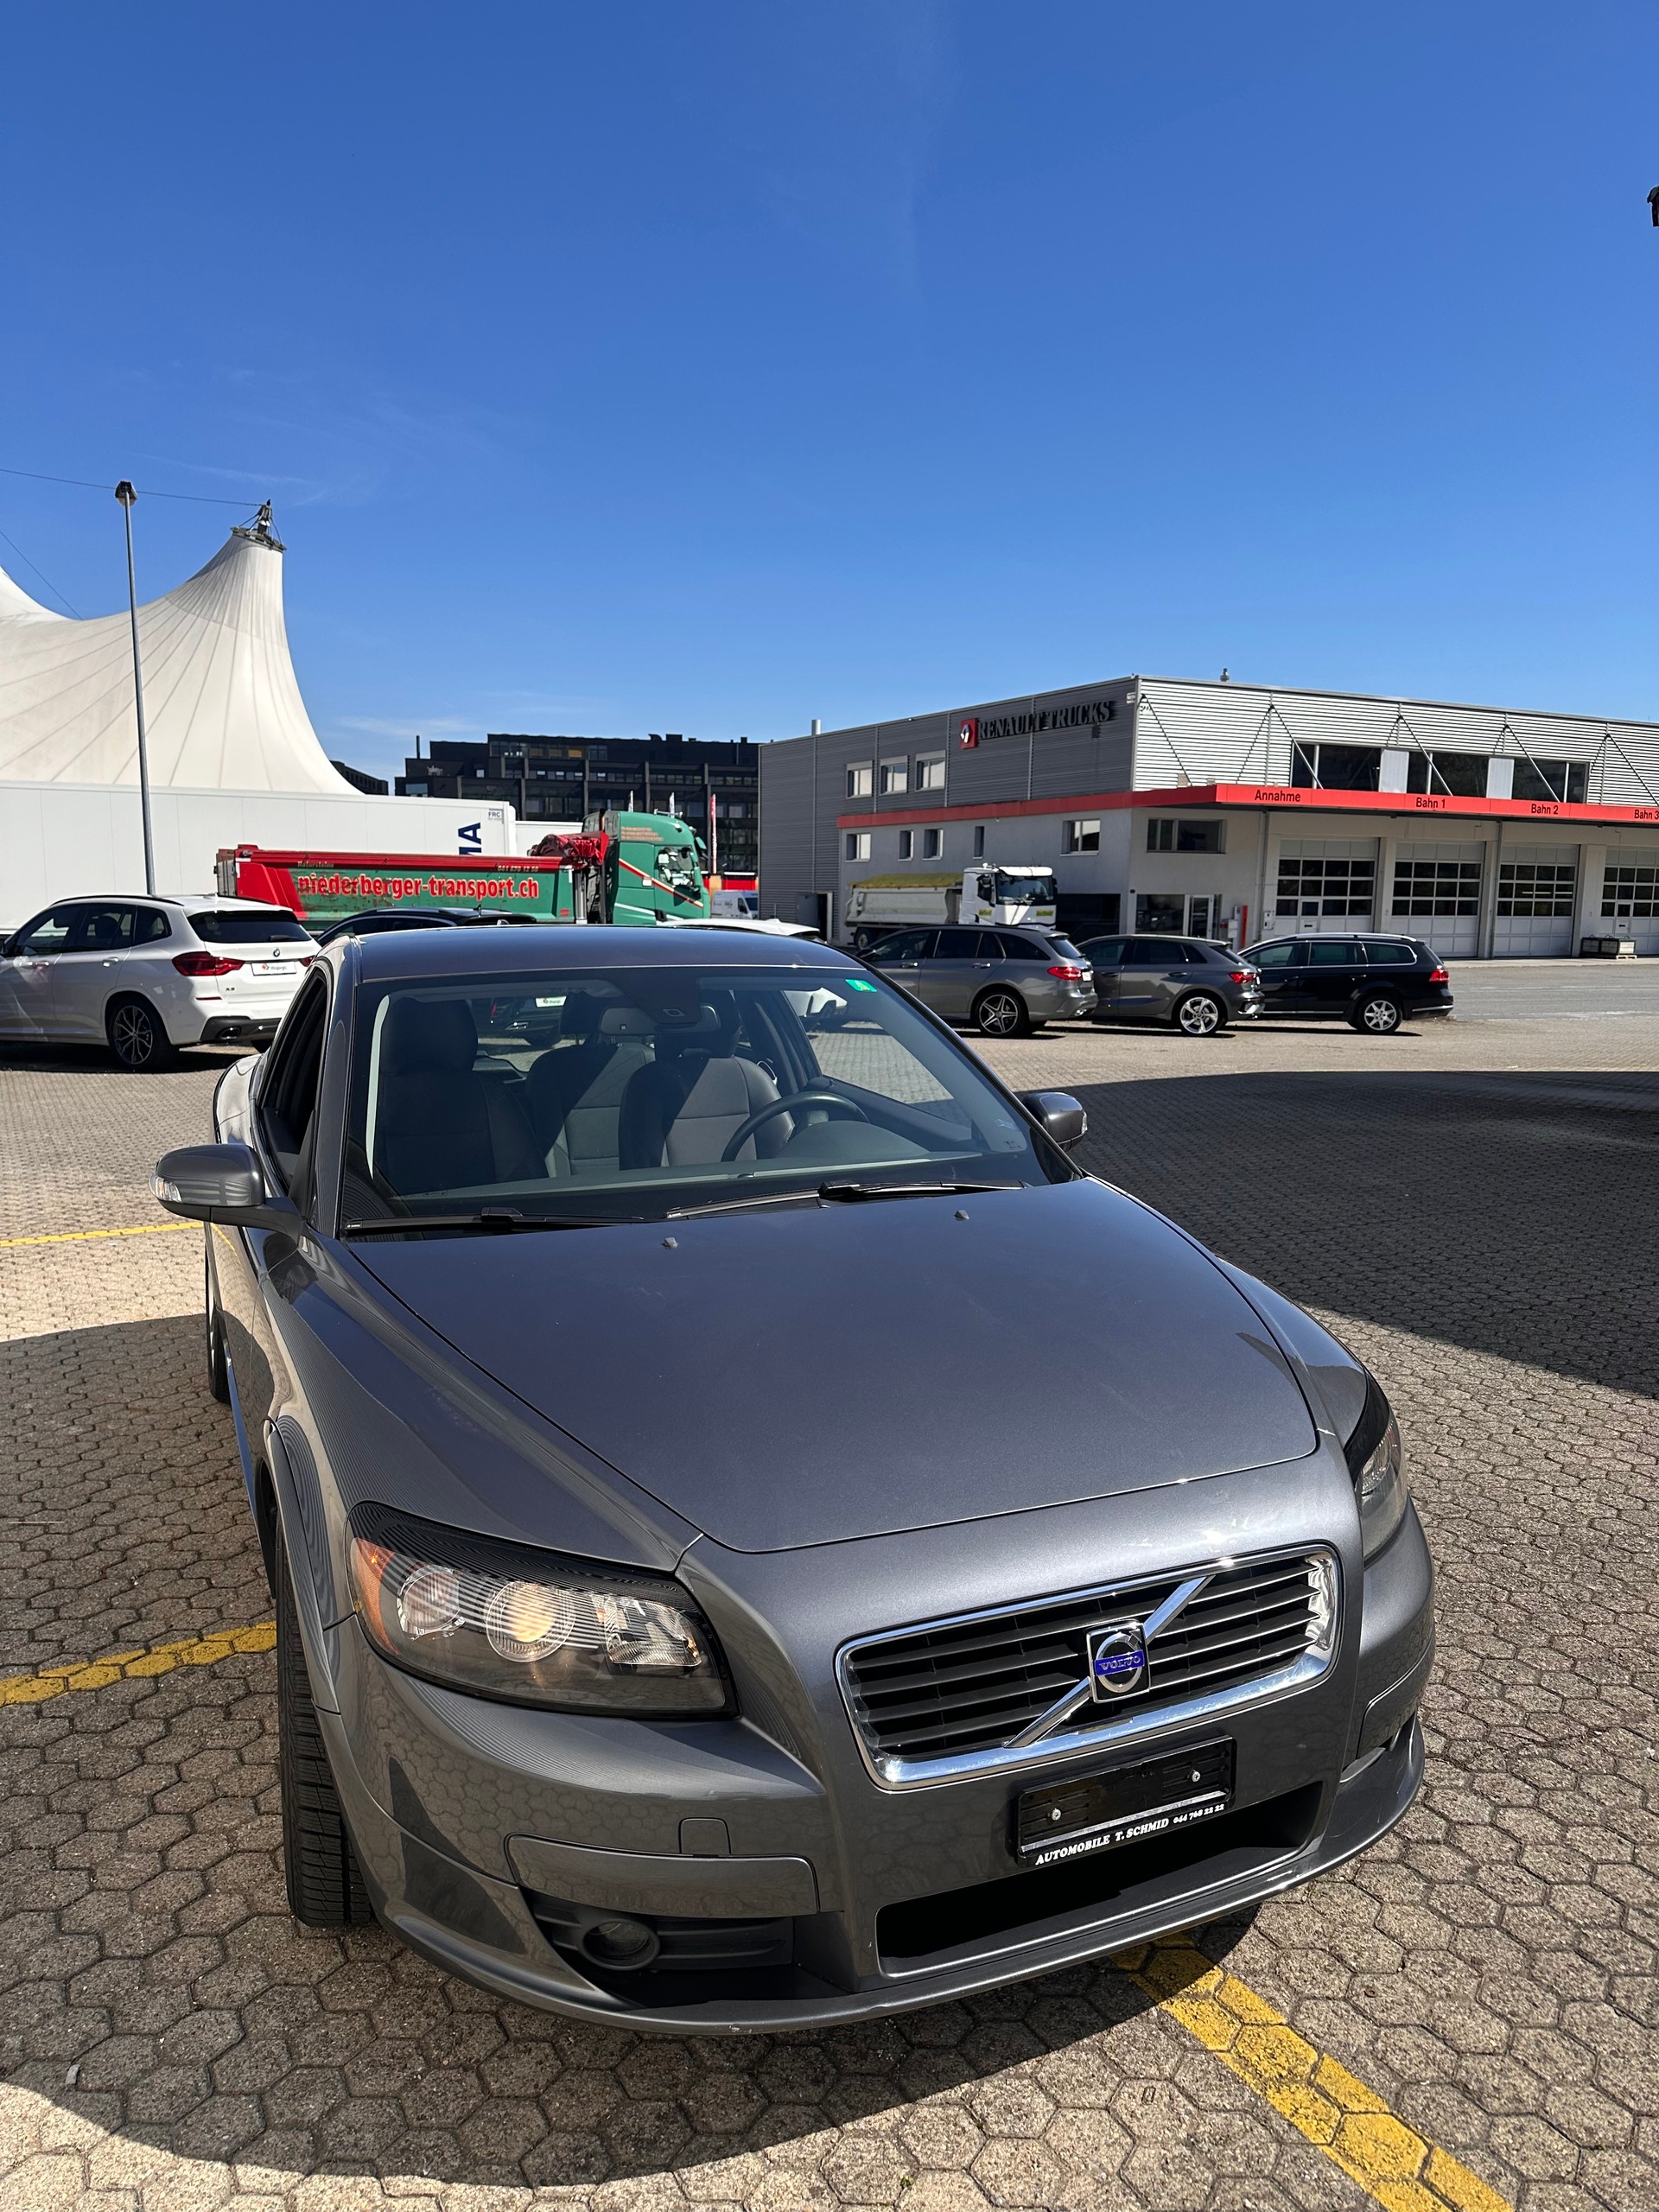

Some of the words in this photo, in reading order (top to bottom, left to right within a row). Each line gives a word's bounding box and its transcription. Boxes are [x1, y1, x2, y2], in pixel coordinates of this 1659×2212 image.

[978, 711, 1043, 740] RENAULT
[1046, 701, 1111, 729] TRUCKS
[1255, 789, 1300, 803] Annahme
[1415, 797, 1439, 809] Bahn
[1440, 799, 1446, 809] 1
[1531, 804, 1551, 815] Bahn
[1553, 805, 1559, 815] 2
[1634, 810, 1653, 819] Bahn
[1654, 810, 1659, 820] 3
[297, 872, 539, 900] niederberger-transport.ch
[1098, 1656, 1141, 1670] VOLVO
[1035, 1834, 1110, 1866] AUTOMOBILE
[1204, 1807, 1213, 1815] 22
[1215, 1803, 1224, 1812] 22
